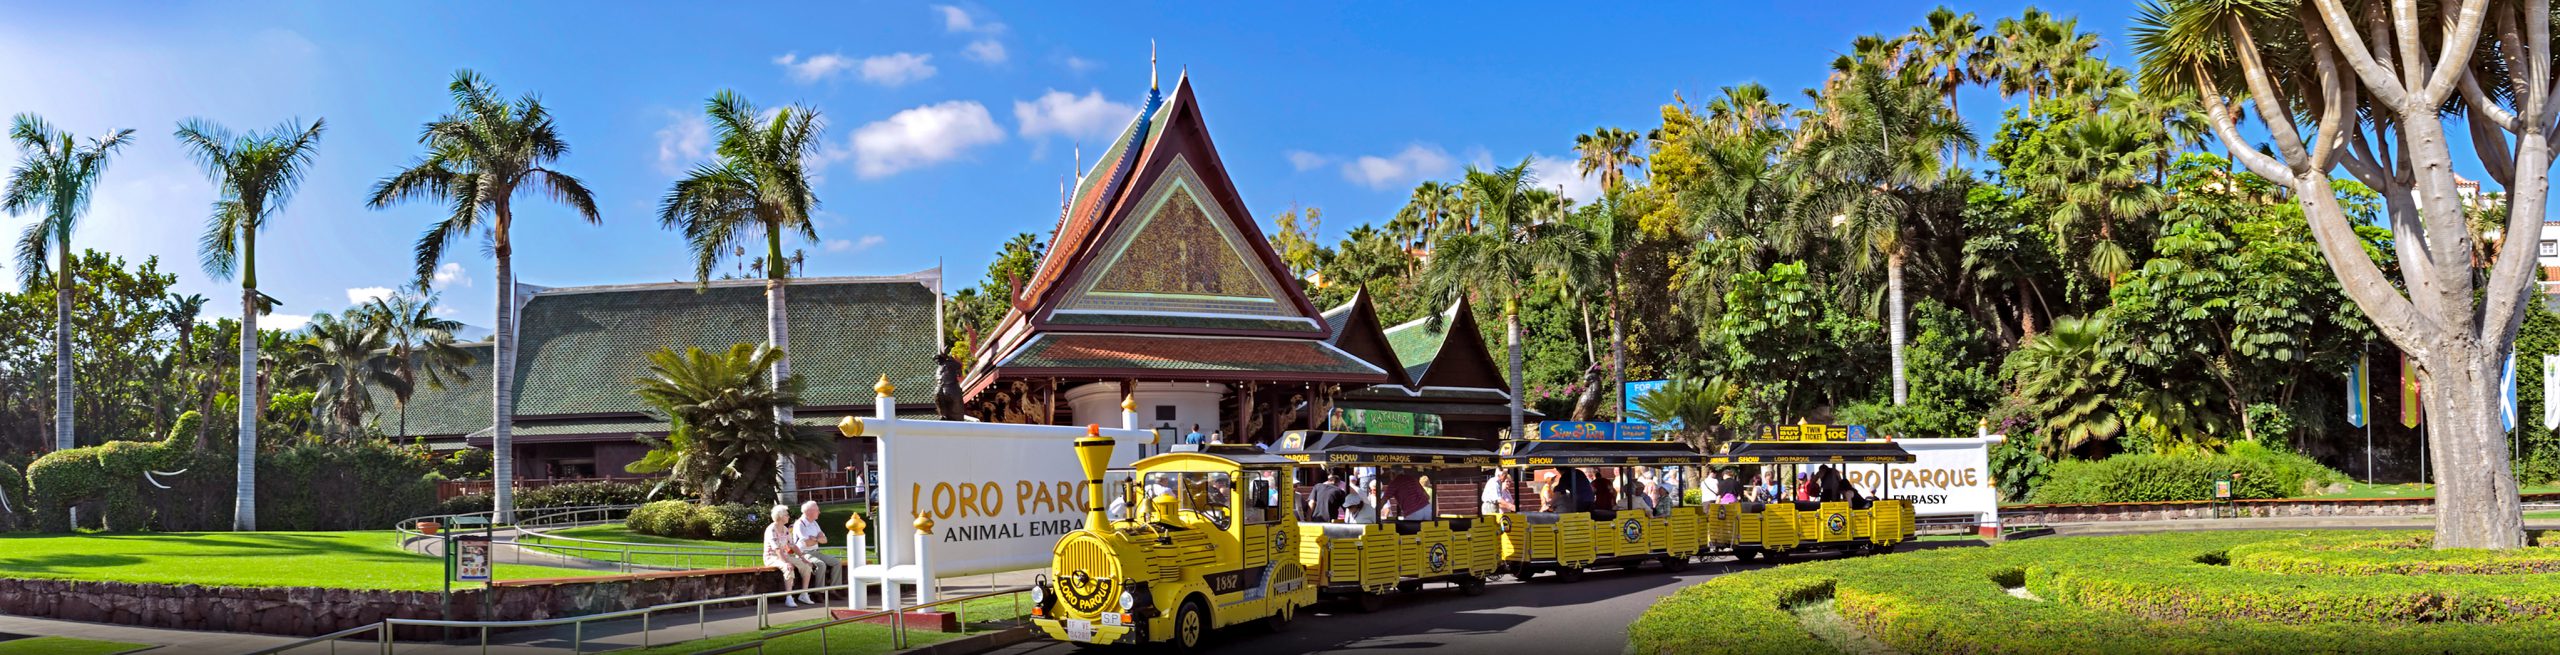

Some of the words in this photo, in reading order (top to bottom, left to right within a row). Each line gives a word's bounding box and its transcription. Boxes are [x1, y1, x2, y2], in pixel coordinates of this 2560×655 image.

[1827, 431, 1846, 439] 10€
[1329, 454, 1358, 463] SHOW
[1390, 455, 1410, 463] PARQUE
[1849, 470, 1881, 489] RO
[1889, 467, 1978, 490] PARQUE
[911, 481, 1004, 520] LORO
[1893, 494, 1948, 505] EMBASSY
[944, 521, 1024, 543] ANIMAL
[1029, 518, 1085, 538] EMBA
[1215, 574, 1239, 592] 1887
[1060, 579, 1078, 605] LORO
[1079, 581, 1109, 610] PARQUE
